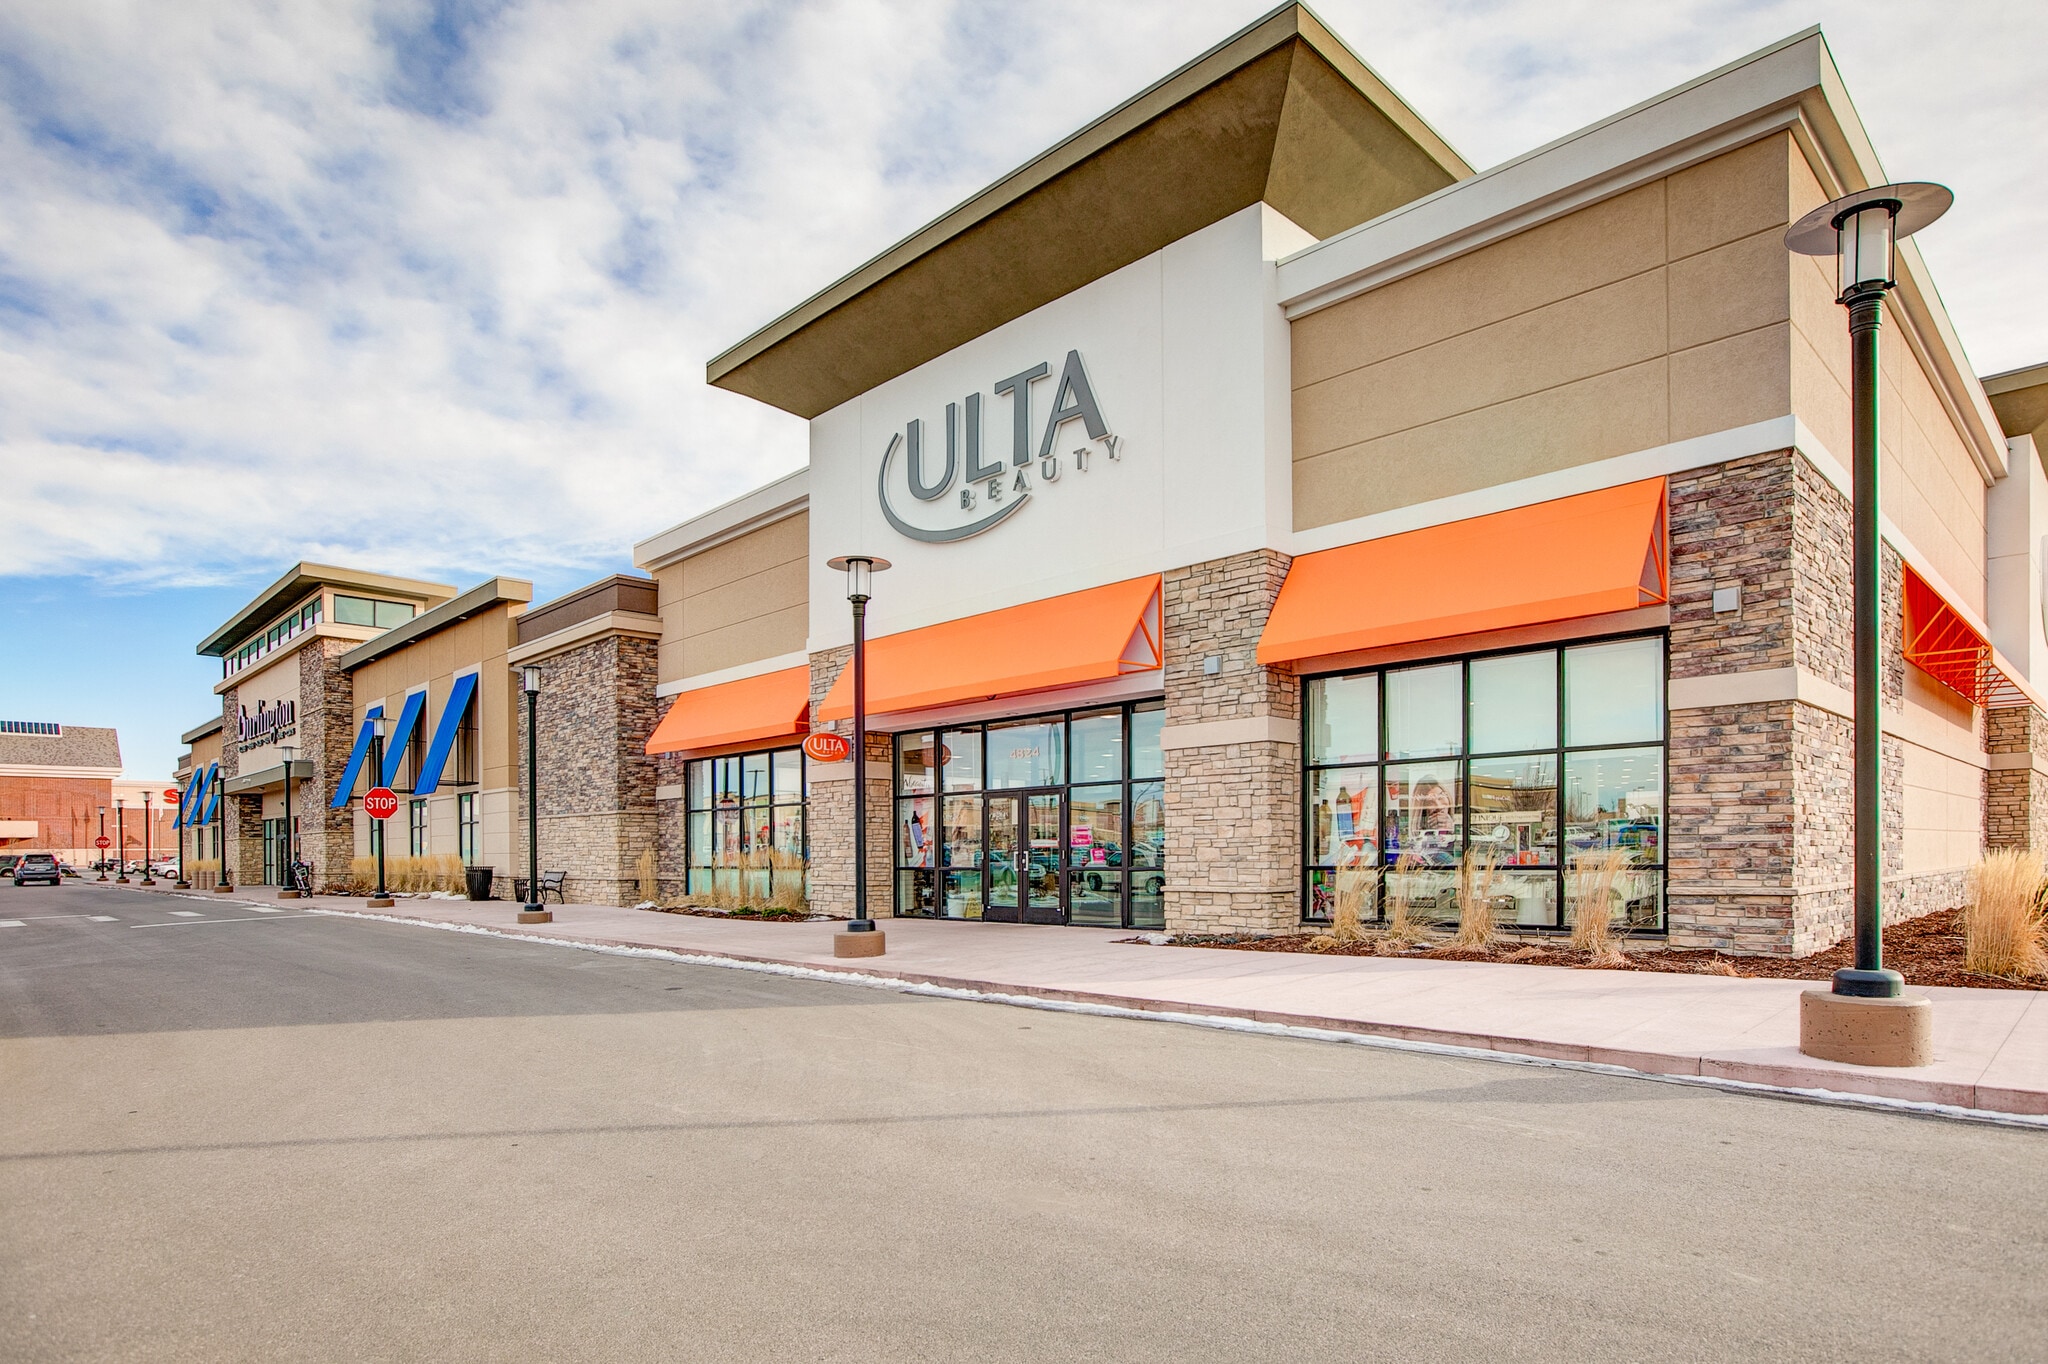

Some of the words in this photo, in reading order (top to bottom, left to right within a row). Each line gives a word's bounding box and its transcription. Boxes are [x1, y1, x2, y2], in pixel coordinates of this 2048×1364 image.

[906, 349, 1111, 501] ULTA
[960, 436, 1124, 511] BEAUTY
[238, 700, 295, 744] Burlington
[812, 737, 845, 753] ULTA
[1010, 746, 1040, 759] 4824
[366, 797, 397, 810] STOP
